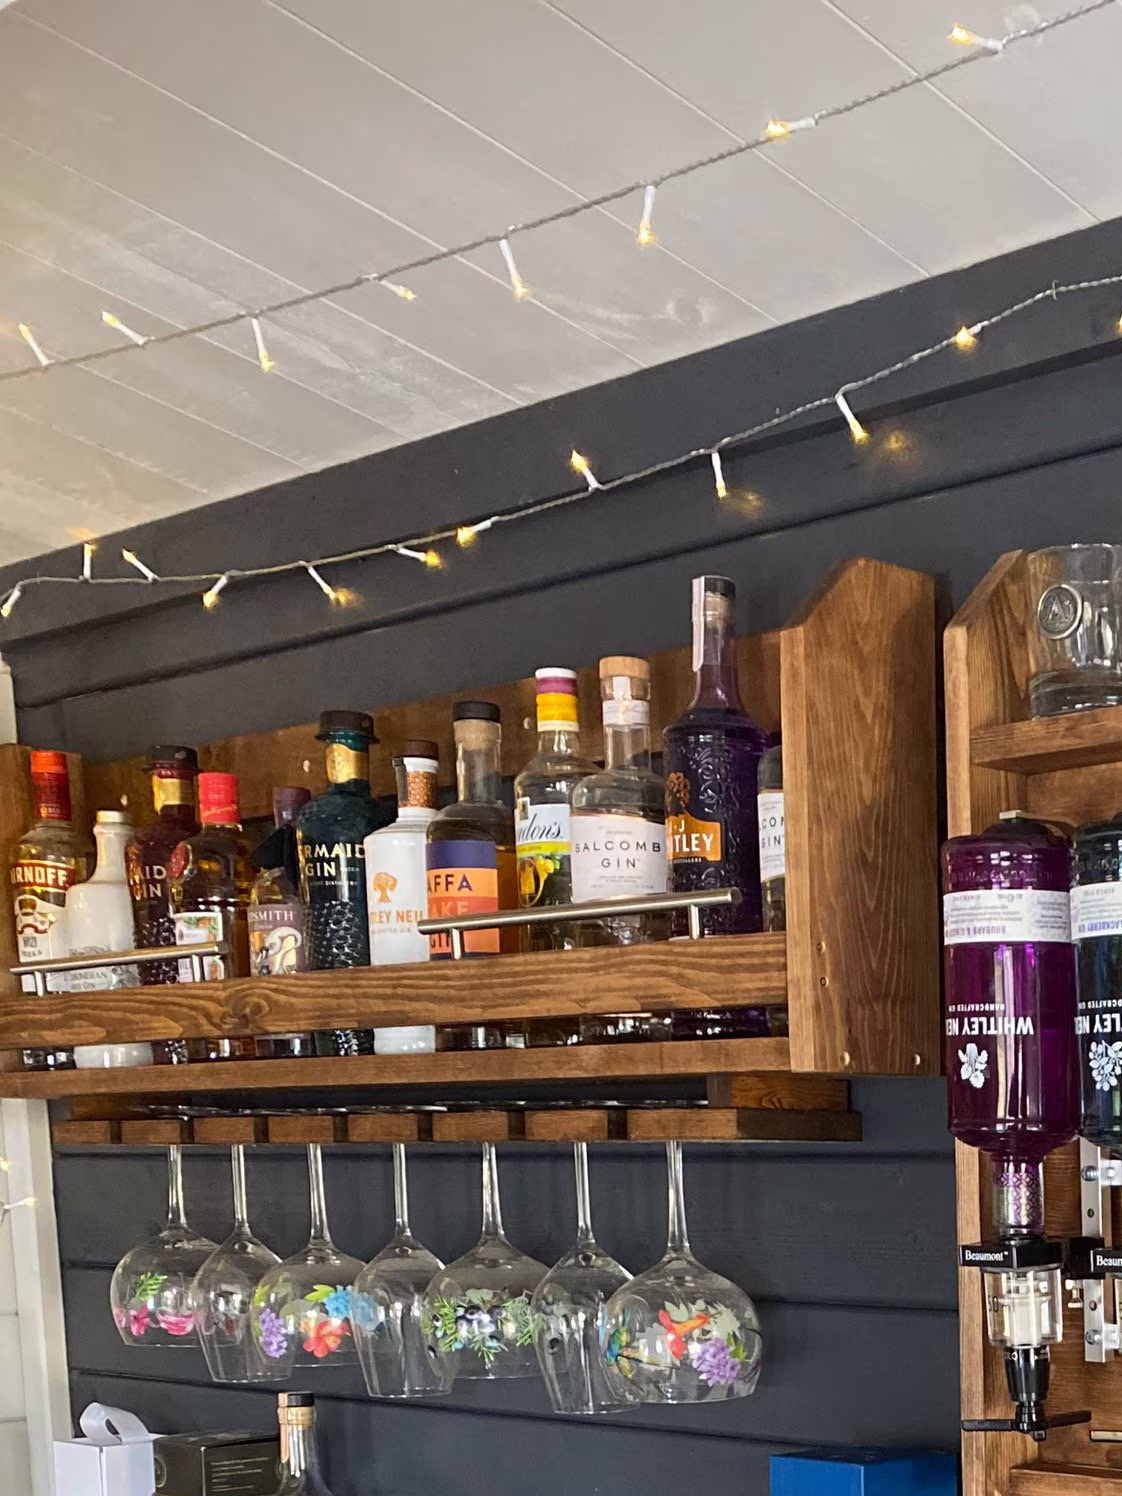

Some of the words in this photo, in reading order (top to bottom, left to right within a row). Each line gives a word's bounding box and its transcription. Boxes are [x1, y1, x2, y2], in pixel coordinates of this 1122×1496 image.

[305, 862, 336, 877] GIN
[601, 858, 637, 869] GIN
[957, 1002, 1005, 1012] HANDCRAFTED
[962, 1016, 1034, 1036] WHITLEY
